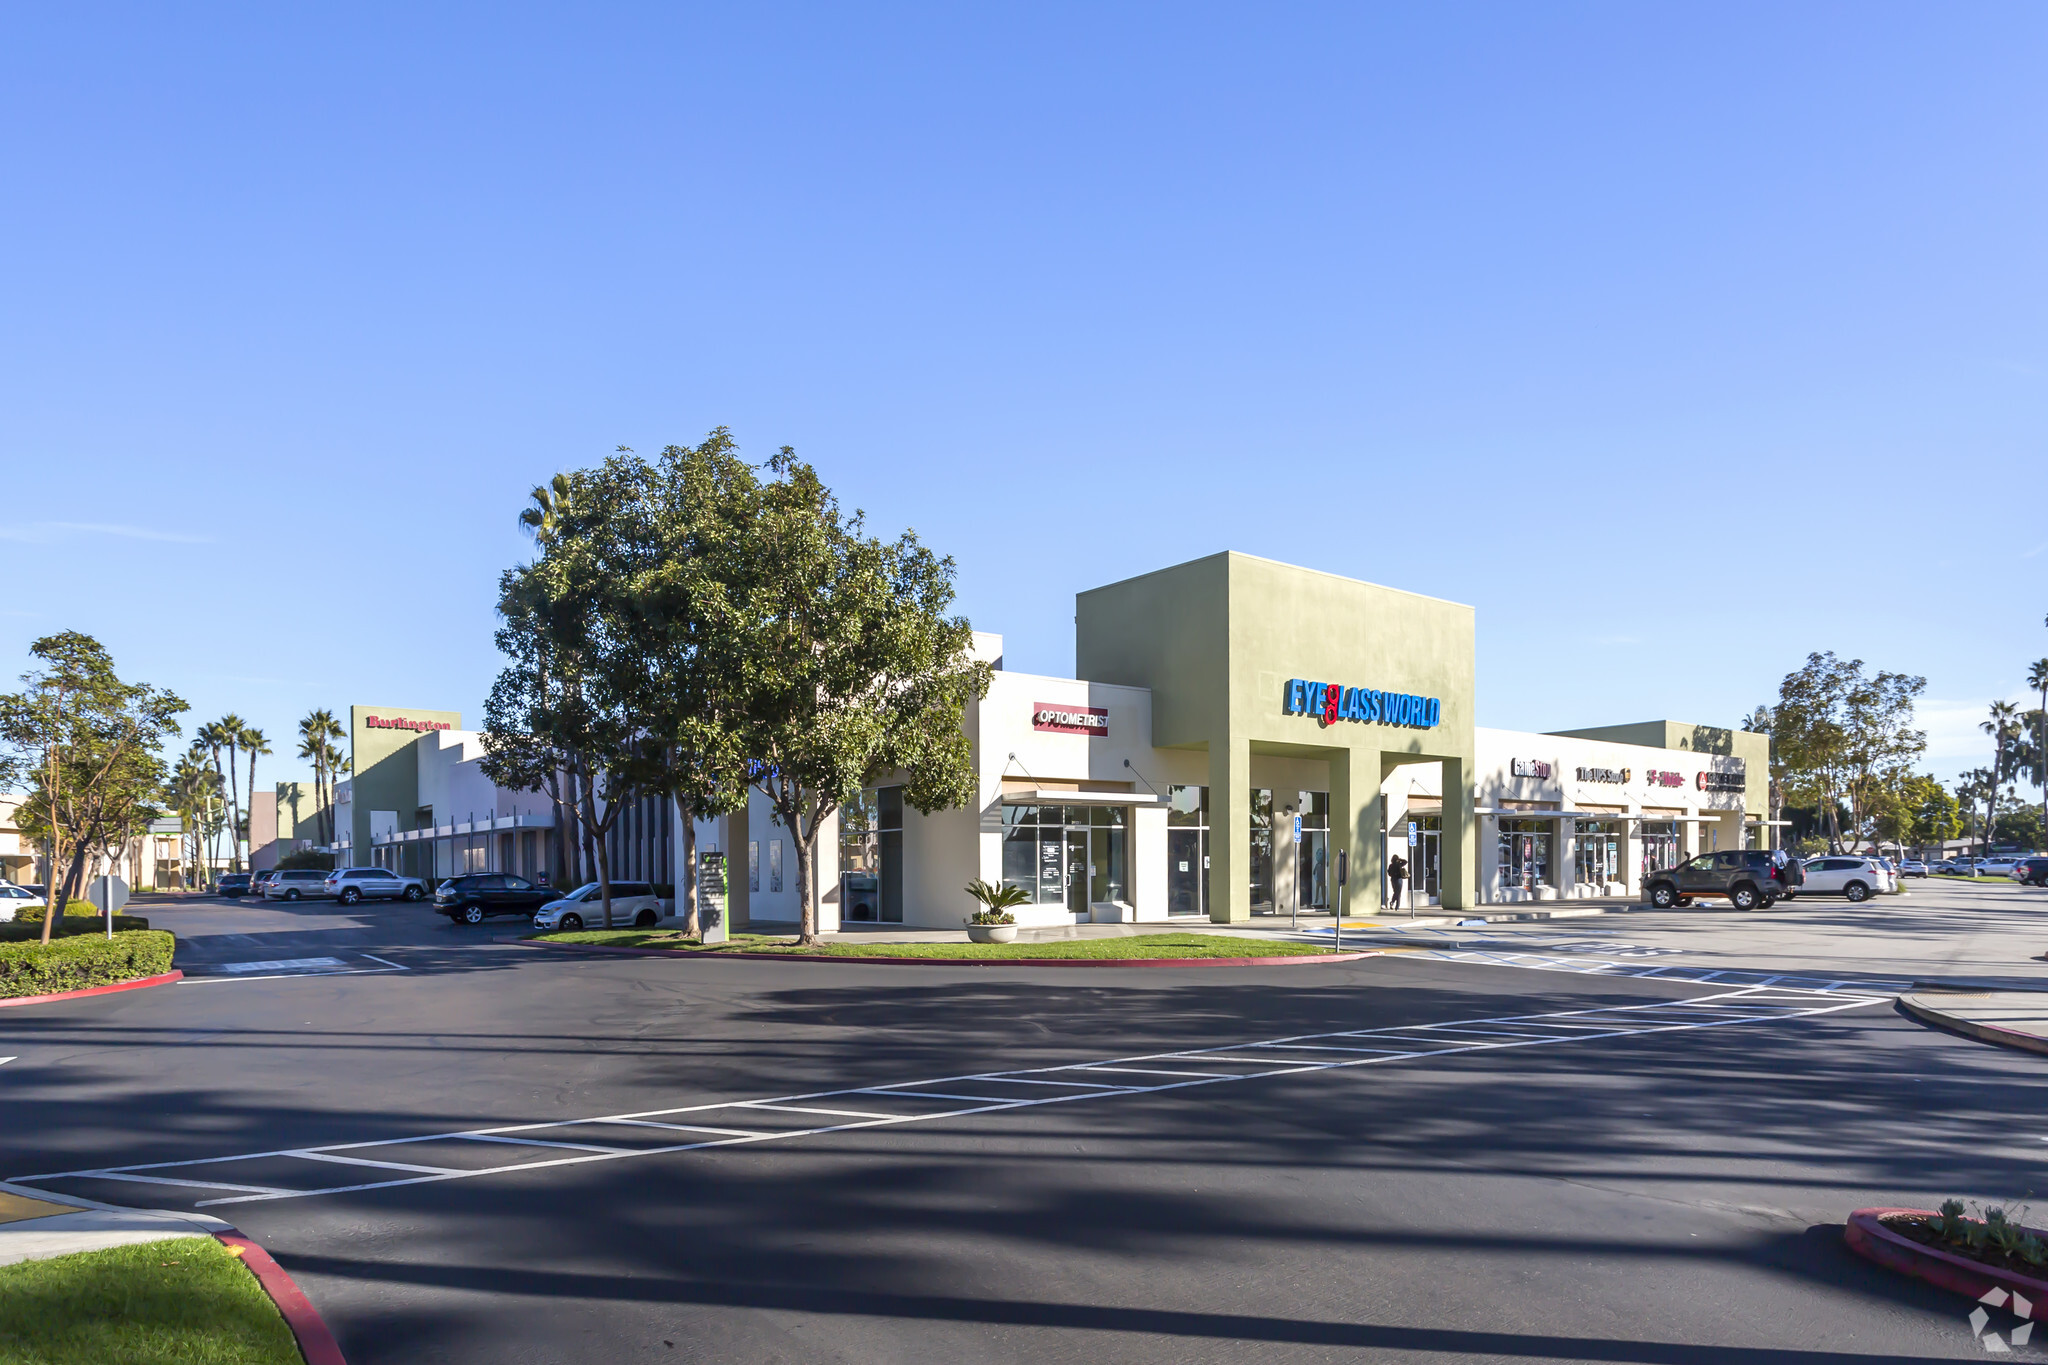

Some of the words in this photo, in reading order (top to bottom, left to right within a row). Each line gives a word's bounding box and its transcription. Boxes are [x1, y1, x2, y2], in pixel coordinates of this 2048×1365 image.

[1039, 709, 1109, 727] OPTOMETRIST
[1383, 691, 1441, 727] WORLD
[368, 715, 451, 731] Burlington
